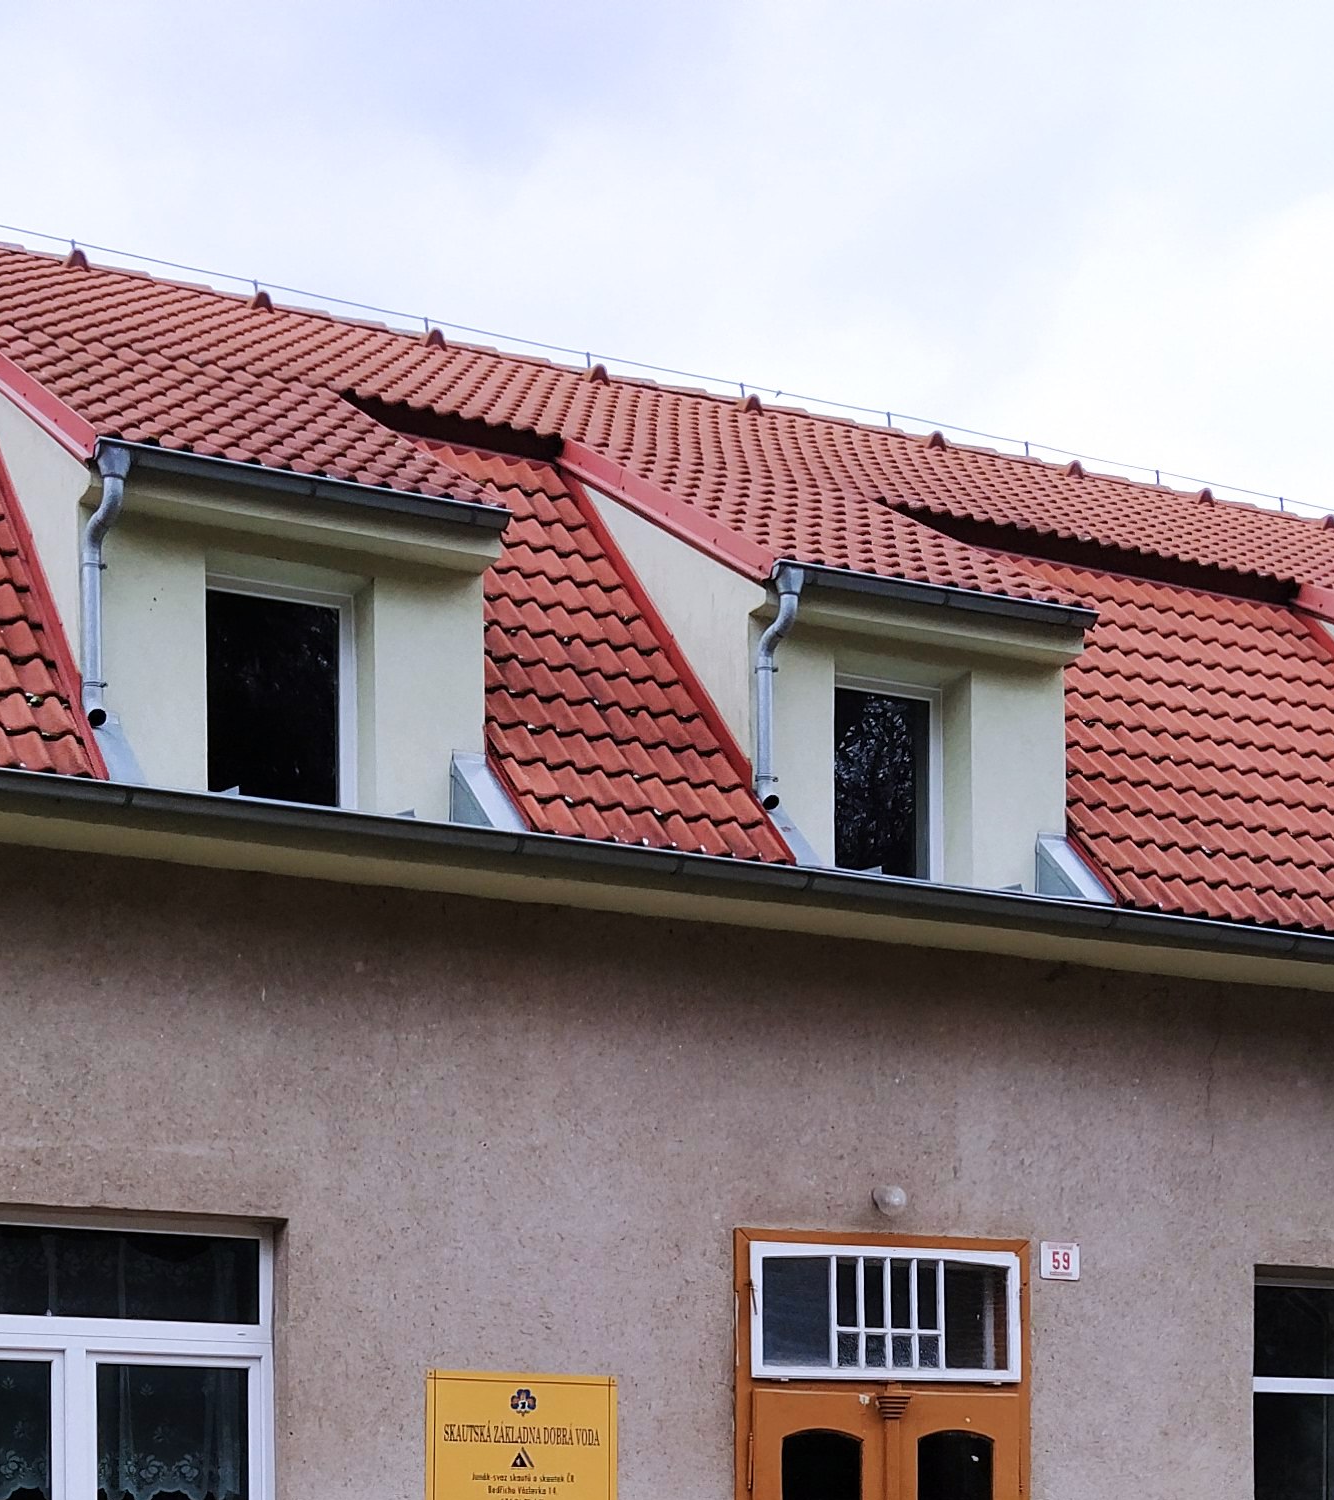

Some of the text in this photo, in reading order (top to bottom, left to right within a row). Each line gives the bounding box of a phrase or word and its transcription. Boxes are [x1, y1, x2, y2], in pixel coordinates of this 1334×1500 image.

[1052, 1250, 1070, 1270] 59
[443, 1420, 601, 1447] SKAUTSKÁ ZÁKLADNA DOBRÁ VODA
